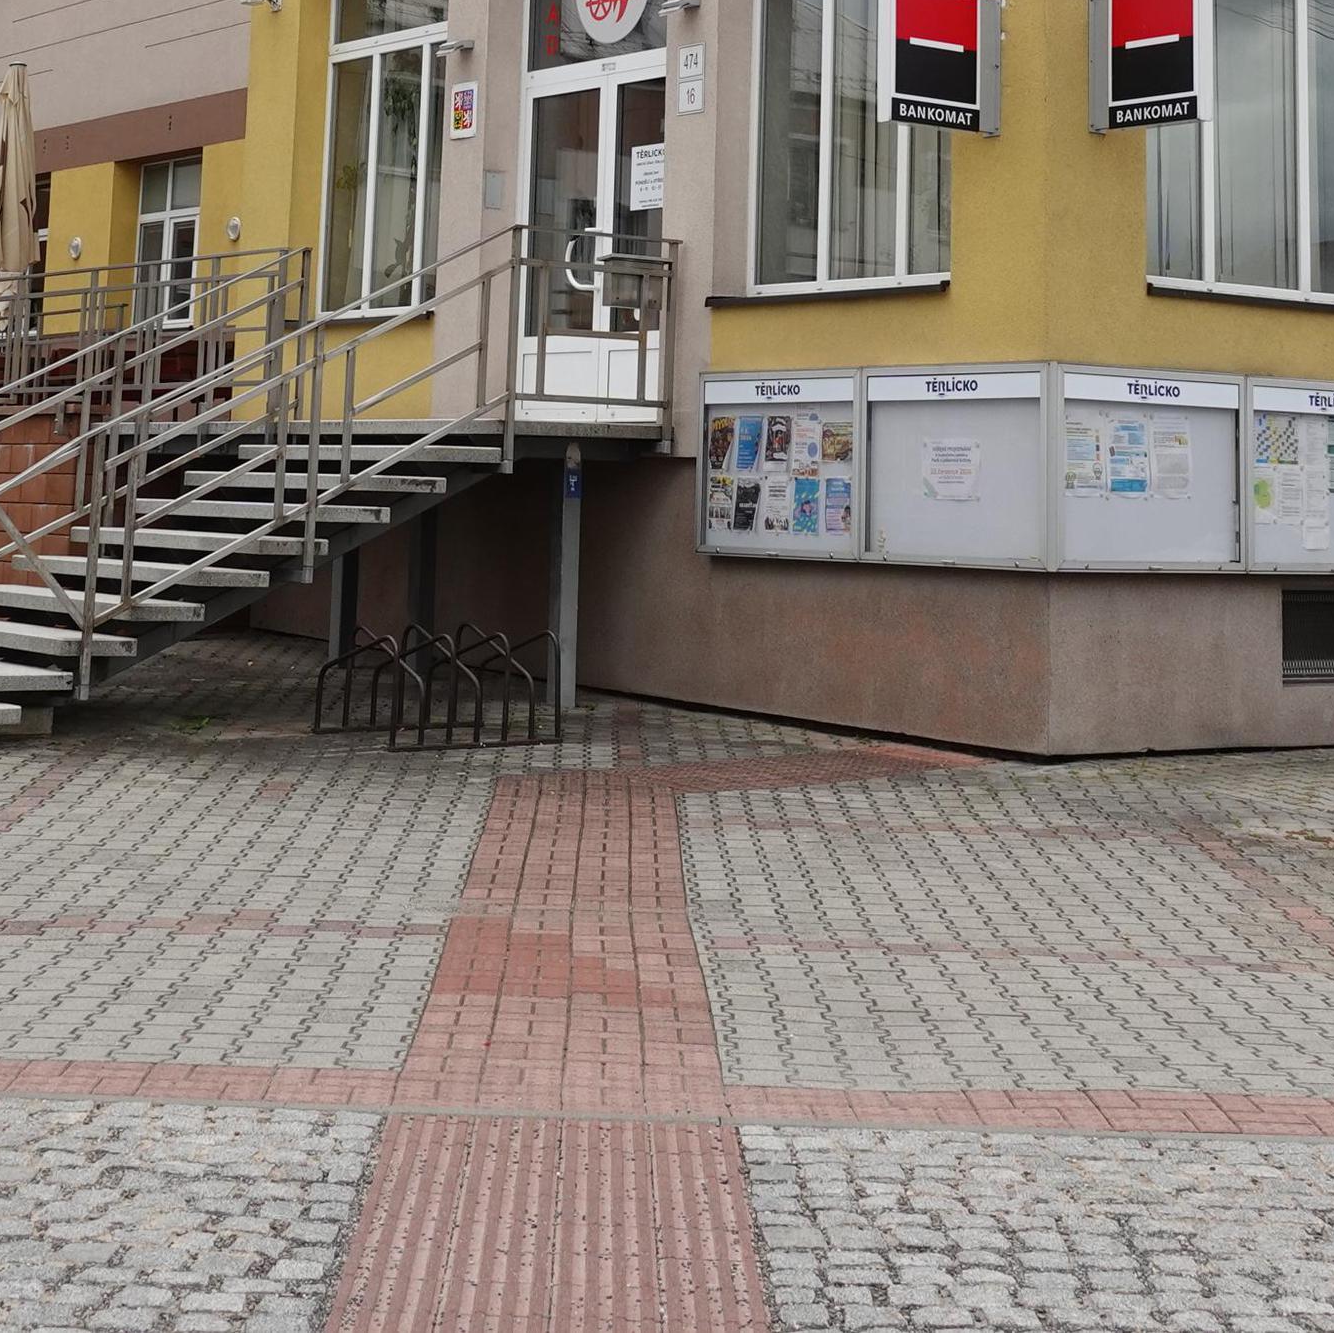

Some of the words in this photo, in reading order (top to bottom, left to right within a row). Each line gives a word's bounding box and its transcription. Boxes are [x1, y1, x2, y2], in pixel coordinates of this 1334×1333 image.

[683, 51, 699, 70] 474
[686, 87, 696, 105] 16
[898, 103, 973, 126] BANKOMAT
[1115, 101, 1190, 123] BANKOMAT
[755, 381, 800, 399] TĚRLICKO
[925, 376, 978, 395] TĚRLICKO
[1127, 379, 1180, 399] TĚRLICKO
